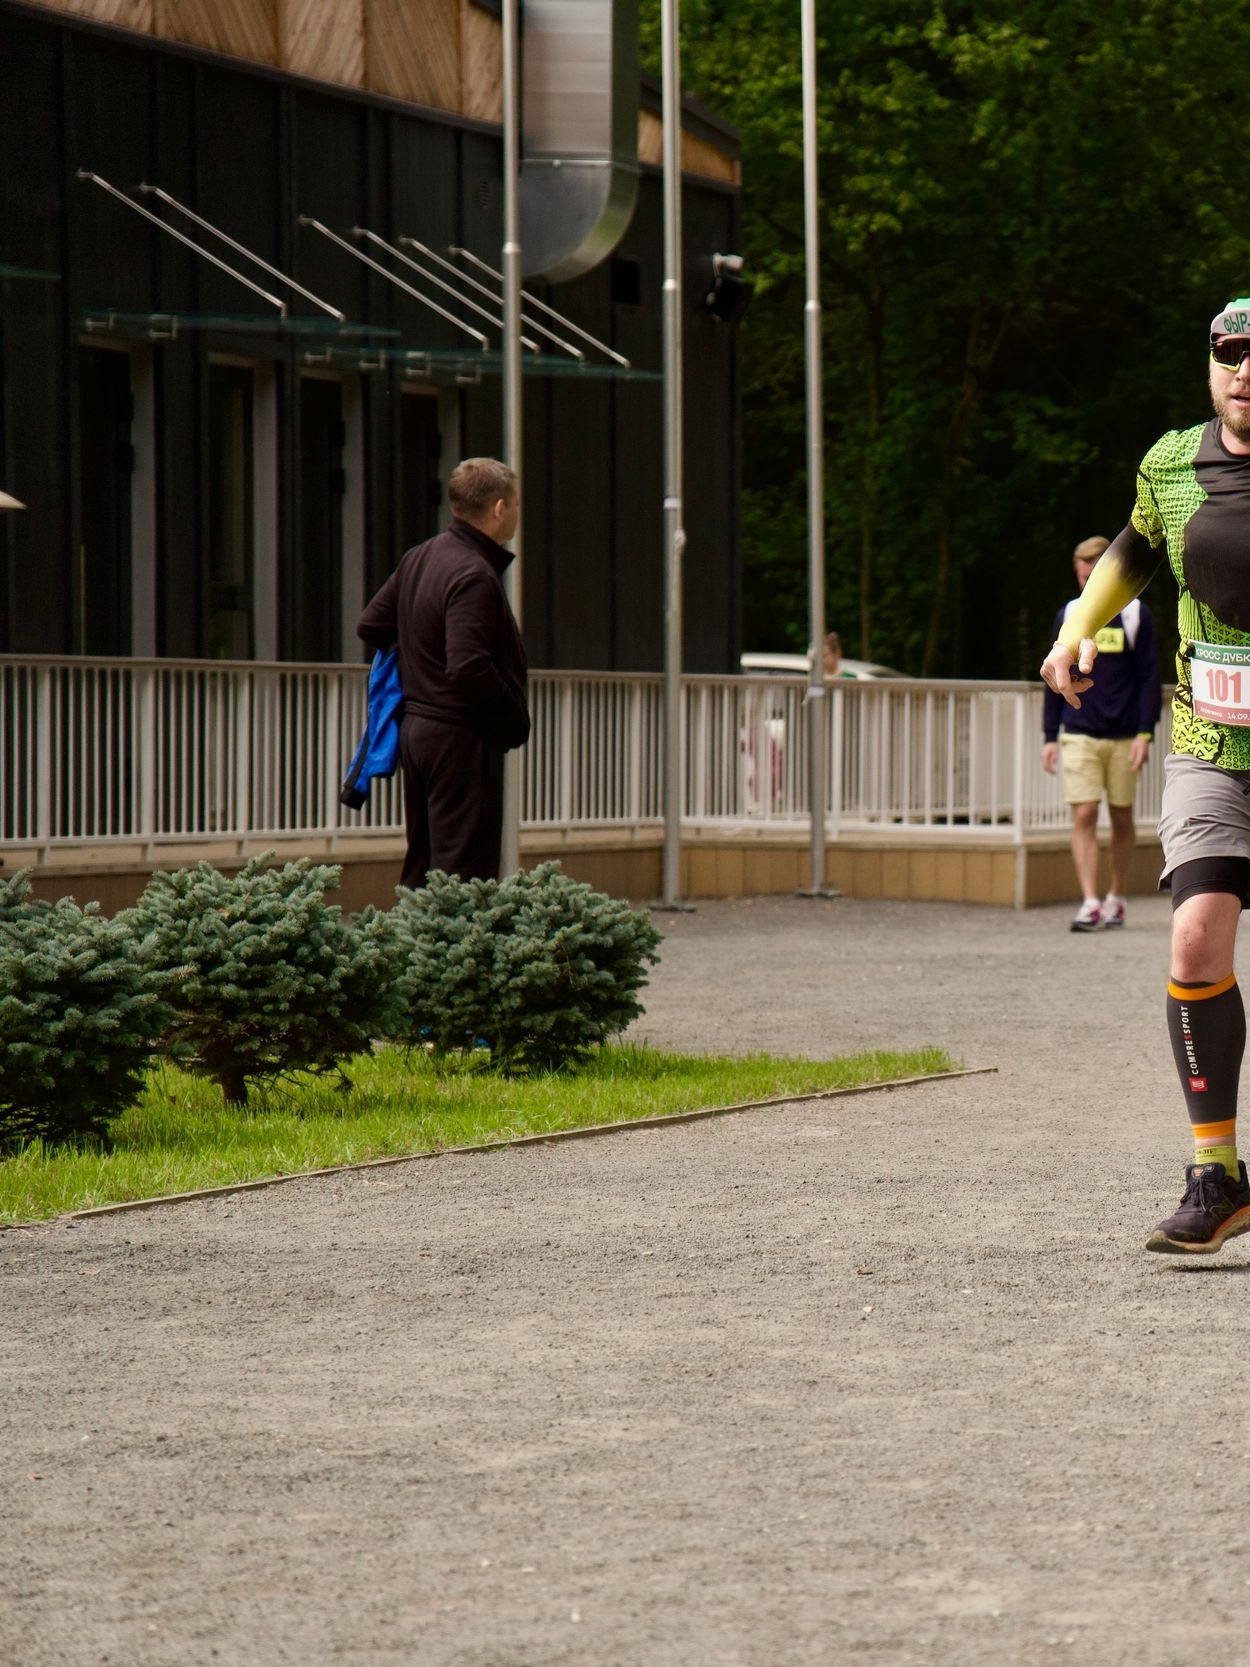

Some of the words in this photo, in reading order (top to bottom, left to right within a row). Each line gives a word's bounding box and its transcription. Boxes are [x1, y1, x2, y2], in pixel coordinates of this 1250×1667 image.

[1195, 648, 1220, 660] КРОСС
[1206, 668, 1242, 704] 101
[1180, 1005, 1199, 1076] COMPRESSPORT
